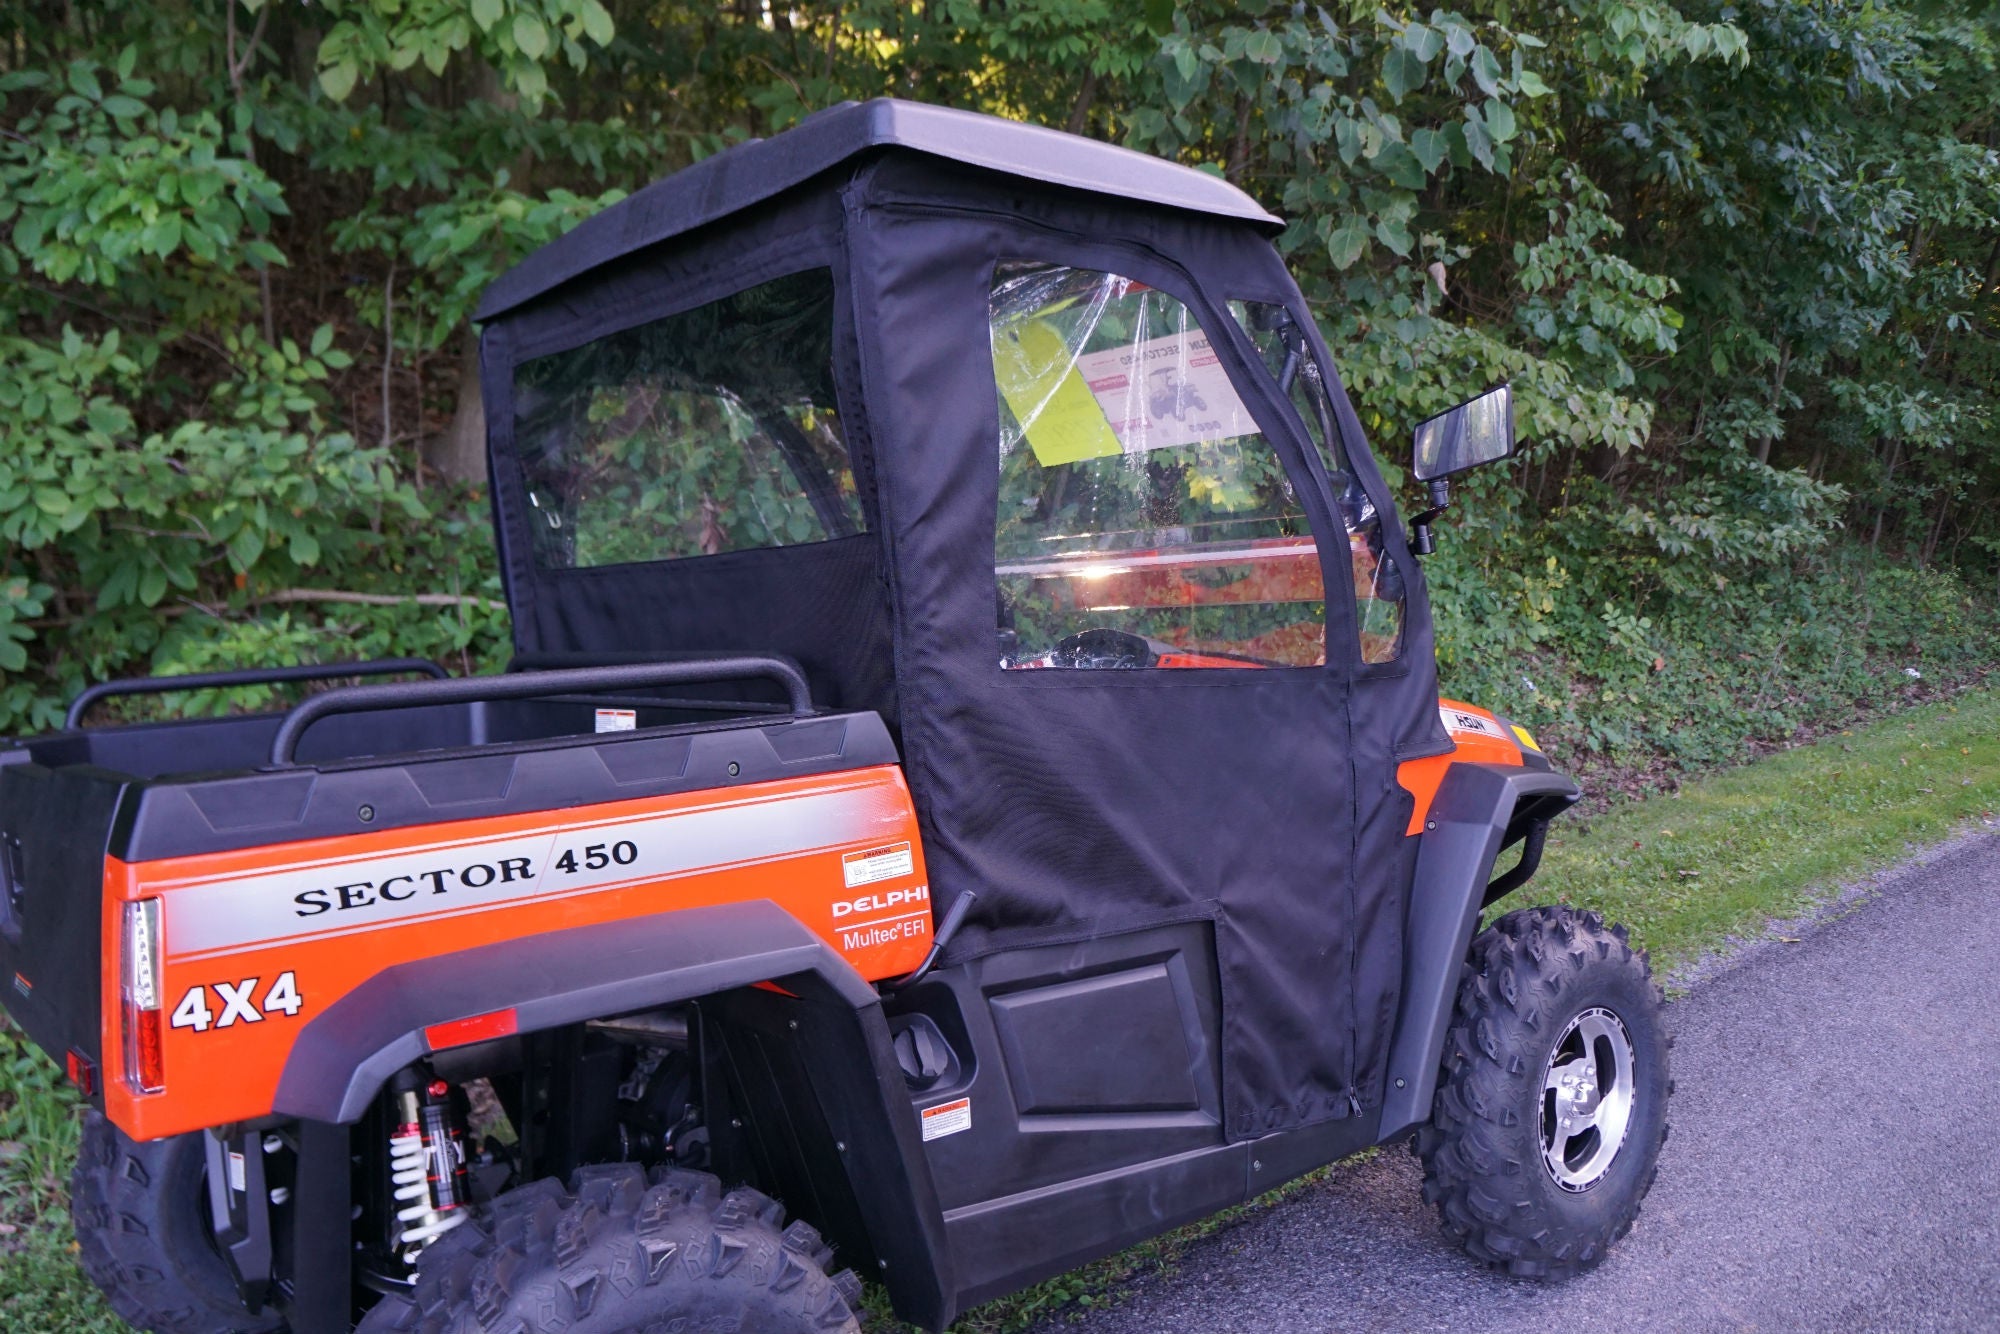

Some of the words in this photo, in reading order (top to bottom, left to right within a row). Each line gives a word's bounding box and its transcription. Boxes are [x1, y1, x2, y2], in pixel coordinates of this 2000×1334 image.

[294, 857, 536, 917] SECTOR
[555, 840, 639, 874] 450
[832, 885, 928, 917] DELPHI
[904, 919, 925, 937] EFI
[170, 970, 303, 1033] 4X4
